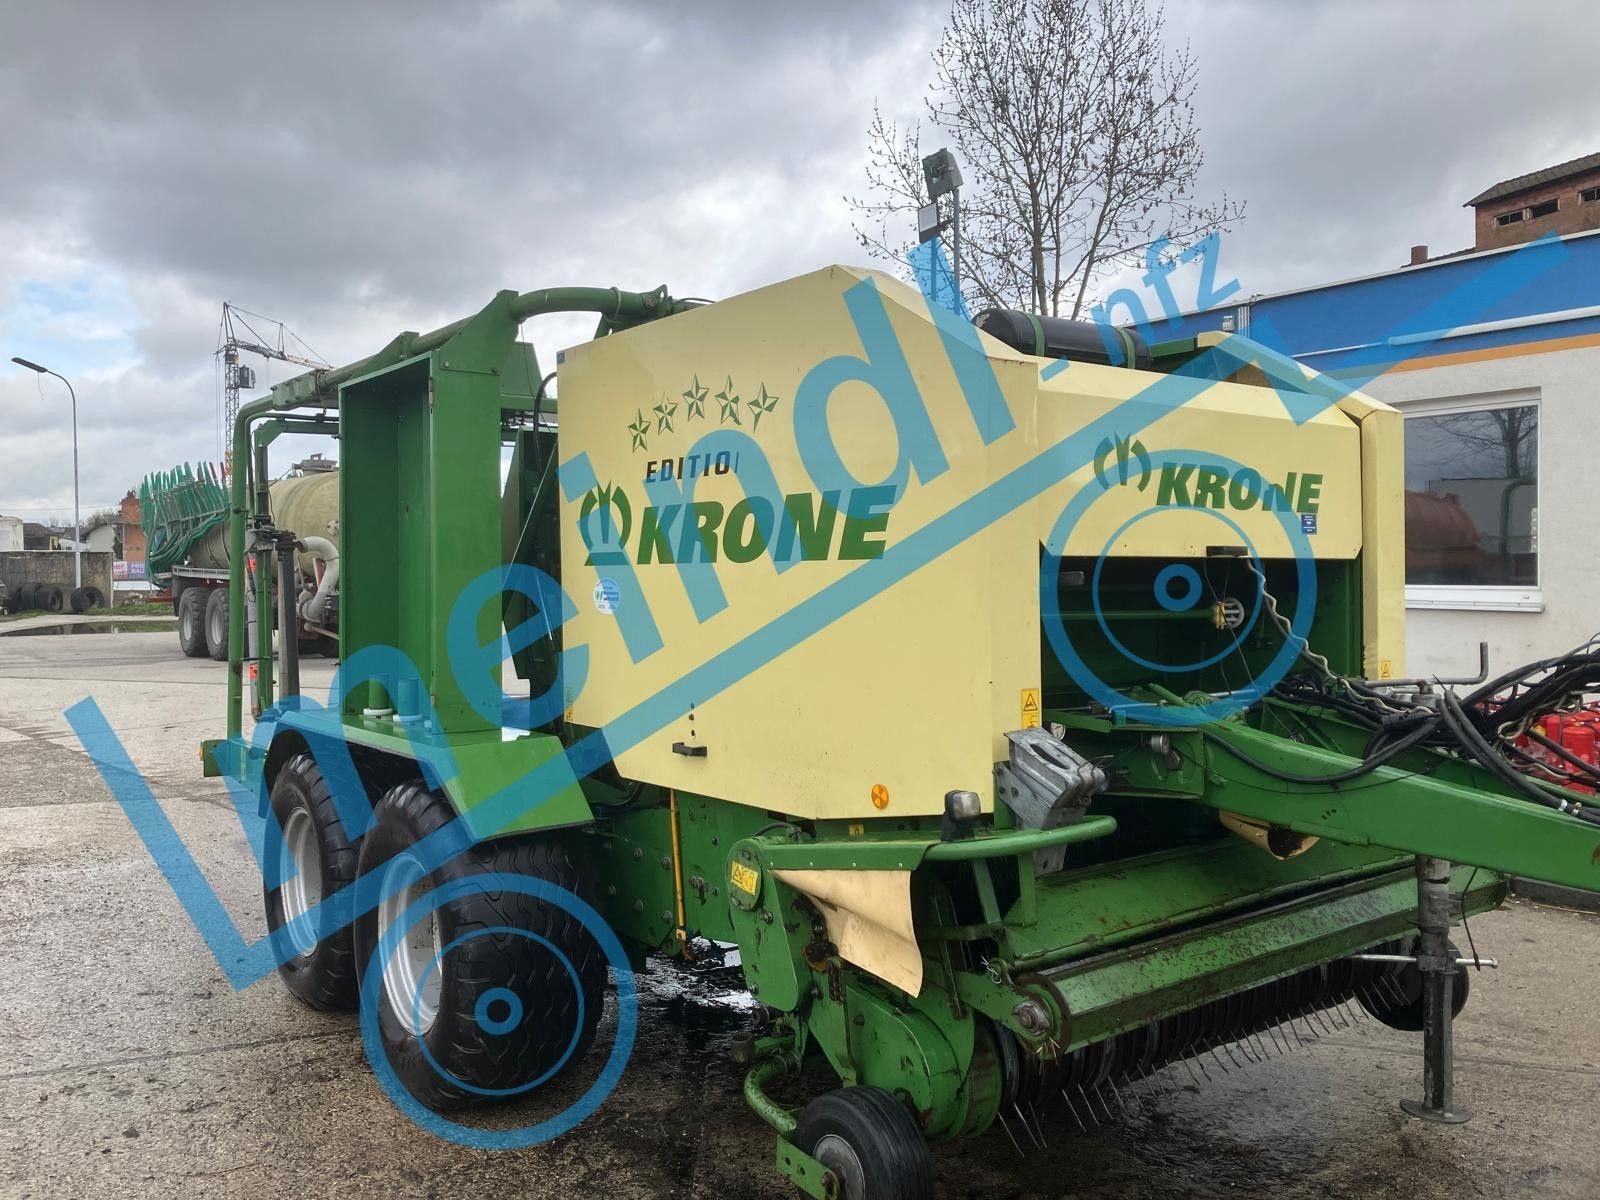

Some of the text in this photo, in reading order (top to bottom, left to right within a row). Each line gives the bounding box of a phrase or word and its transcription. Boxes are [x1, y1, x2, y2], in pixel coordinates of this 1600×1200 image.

[645, 450, 740, 484] EDITIO
[1156, 462, 1324, 514] KRONE
[637, 484, 897, 566] KRONE
